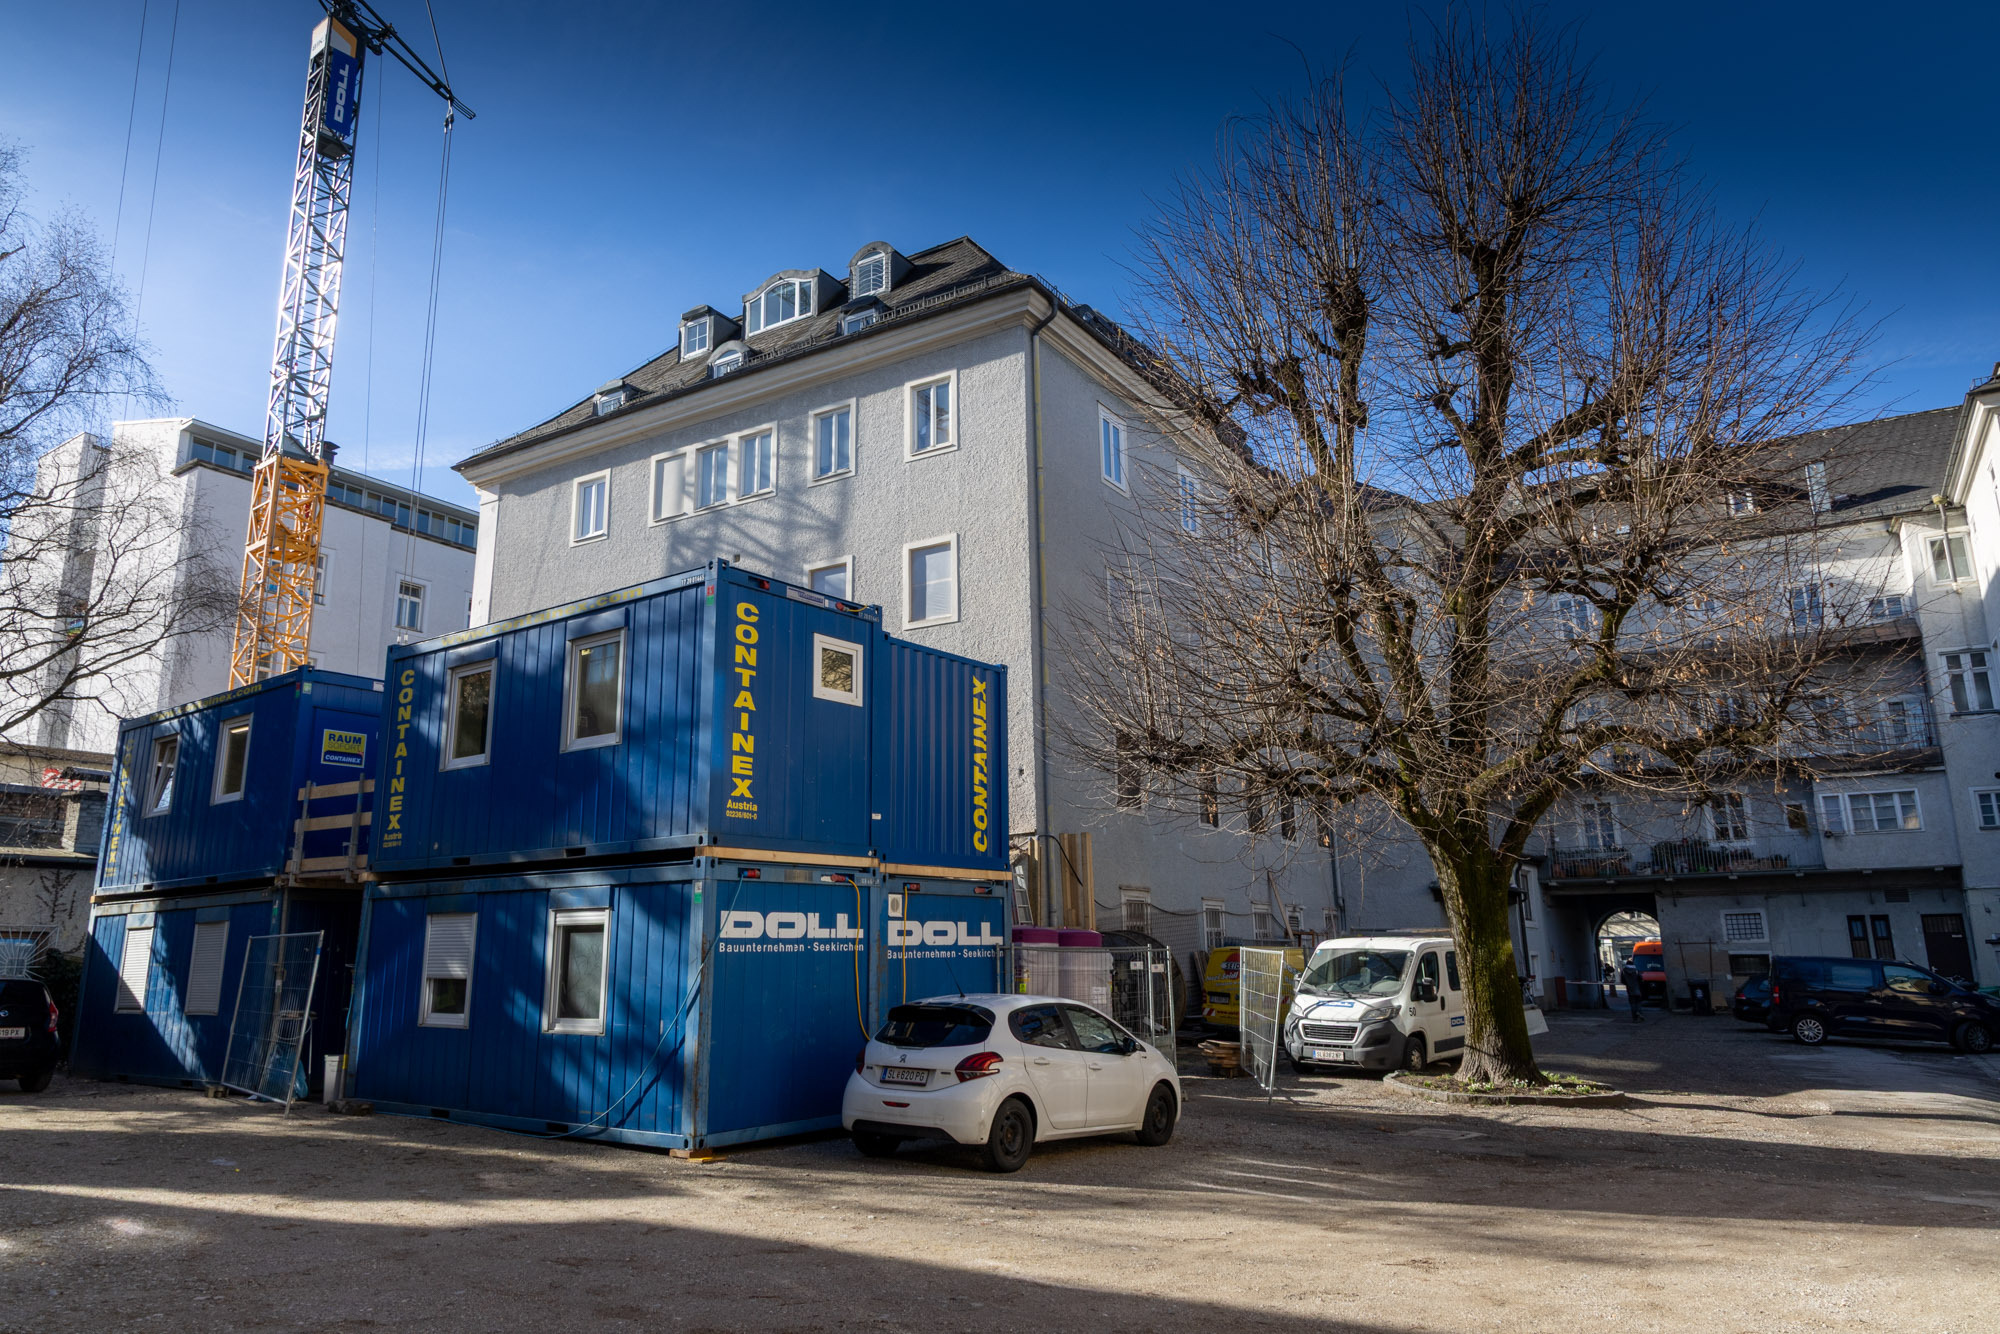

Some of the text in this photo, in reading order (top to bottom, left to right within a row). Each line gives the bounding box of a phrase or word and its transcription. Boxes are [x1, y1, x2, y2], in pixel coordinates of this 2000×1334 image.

[334, 64, 349, 123] DOLL
[441, 587, 643, 647] www.containex.com
[731, 602, 760, 798] CONTAINEX
[328, 733, 362, 745] RAUM
[327, 741, 362, 752] SOFORT
[387, 669, 415, 831] CONTAINEX
[325, 754, 361, 764] CONTAINEX
[973, 675, 988, 853] CONTAINEX
[726, 799, 758, 812] Austria
[720, 910, 864, 939] DOLL
[888, 920, 1004, 946] DOLL
[719, 942, 805, 953] Bauunternehmen
[887, 949, 956, 960] Bauunternehmen
[963, 948, 1004, 958] Seekirchn
[1225, 962, 1241, 970] SEID
[1409, 1006, 1417, 1017] 50
[888, 1070, 925, 1082] SL 620 PG
